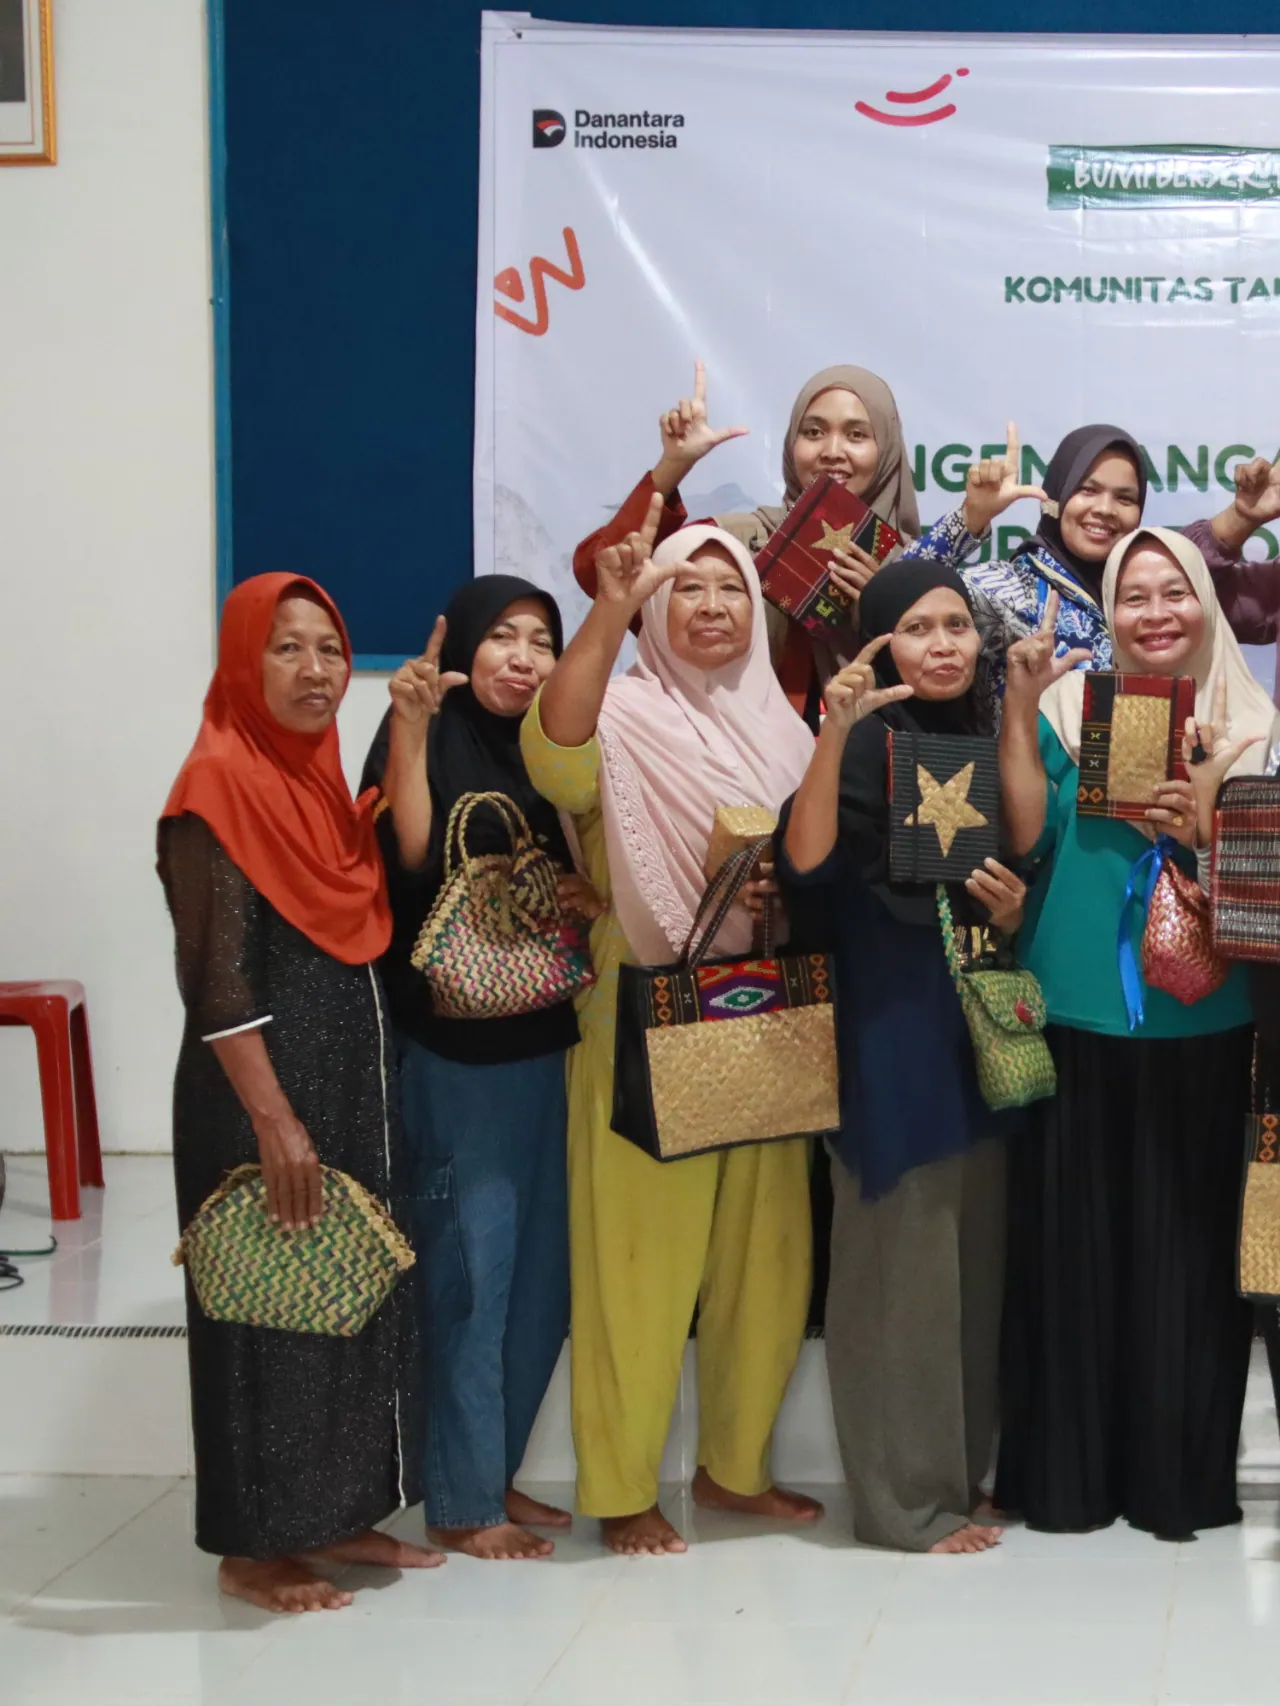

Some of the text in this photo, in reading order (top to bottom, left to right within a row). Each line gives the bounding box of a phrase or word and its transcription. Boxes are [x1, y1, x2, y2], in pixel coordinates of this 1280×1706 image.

[574, 109, 685, 128] Danantara
[574, 130, 678, 149] Indonesia
[1003, 275, 1213, 306] KOMUNITAS
